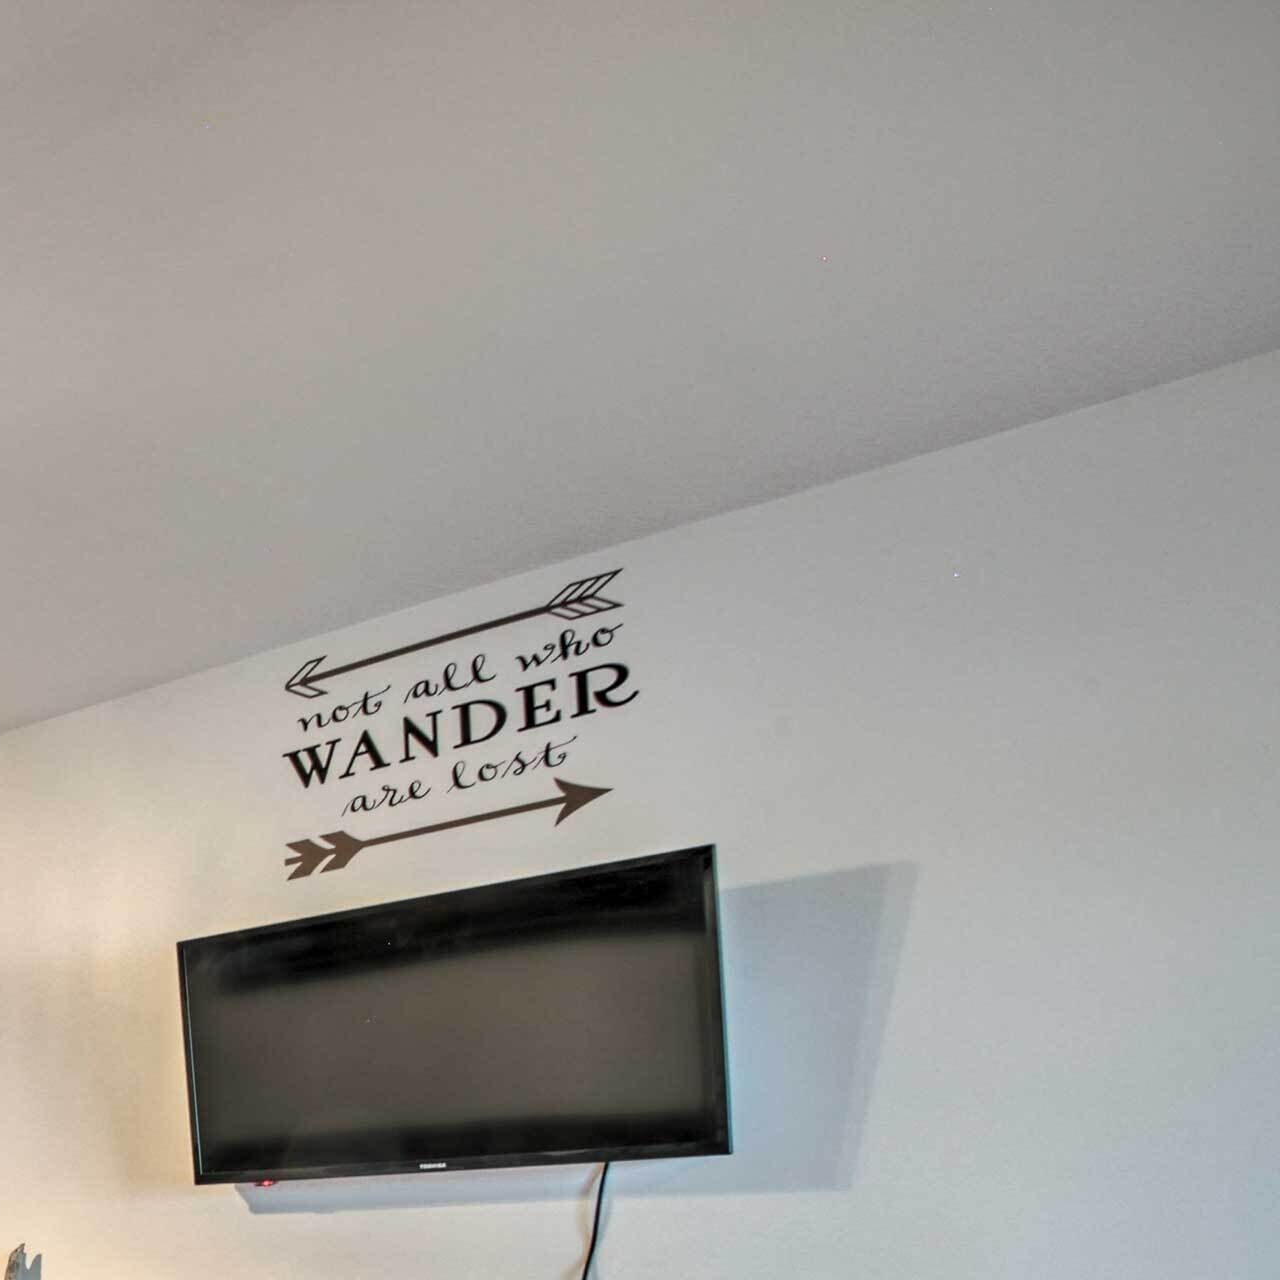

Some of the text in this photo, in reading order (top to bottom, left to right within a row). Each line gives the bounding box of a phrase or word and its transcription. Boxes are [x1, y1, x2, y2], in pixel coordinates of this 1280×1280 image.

[282, 662, 640, 789] WANDER
[297, 623, 624, 733] not all who
[341, 736, 577, 817] are lost
